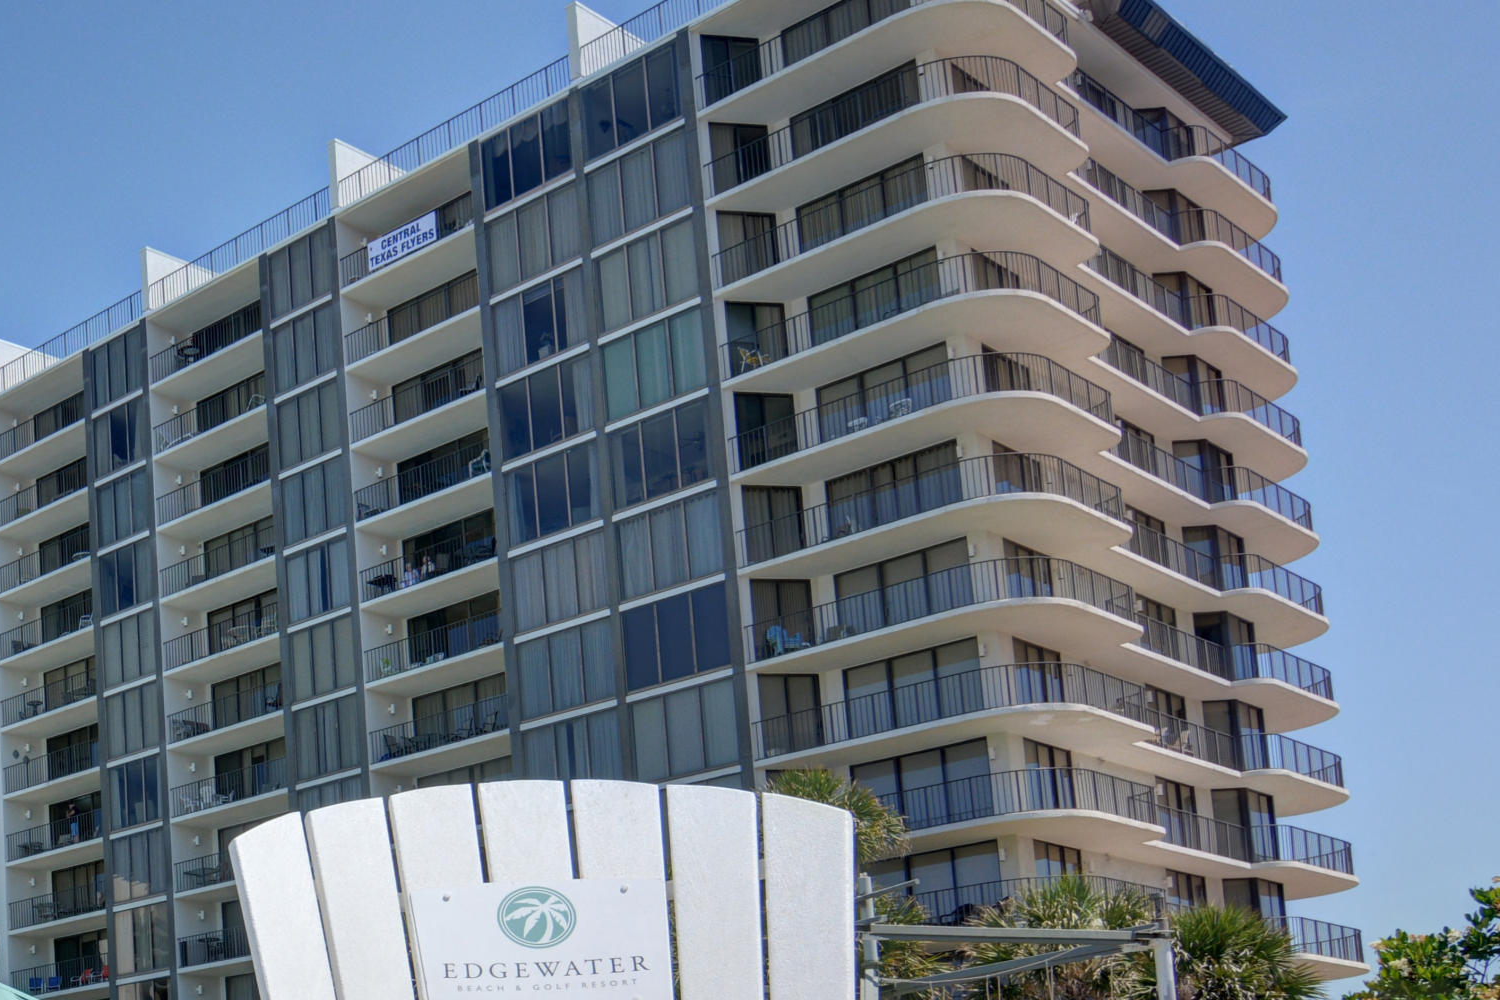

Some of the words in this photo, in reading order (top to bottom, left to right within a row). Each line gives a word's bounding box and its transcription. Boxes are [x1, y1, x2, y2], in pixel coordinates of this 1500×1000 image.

[370, 246, 398, 267] TEXAS
[401, 228, 434, 253] FLYERS
[381, 223, 420, 250] CENTRAL
[443, 955, 650, 979] EDGEWATER
[457, 984, 504, 992] BEACH
[532, 982, 571, 991] GOLF
[582, 979, 638, 989] RESORT
